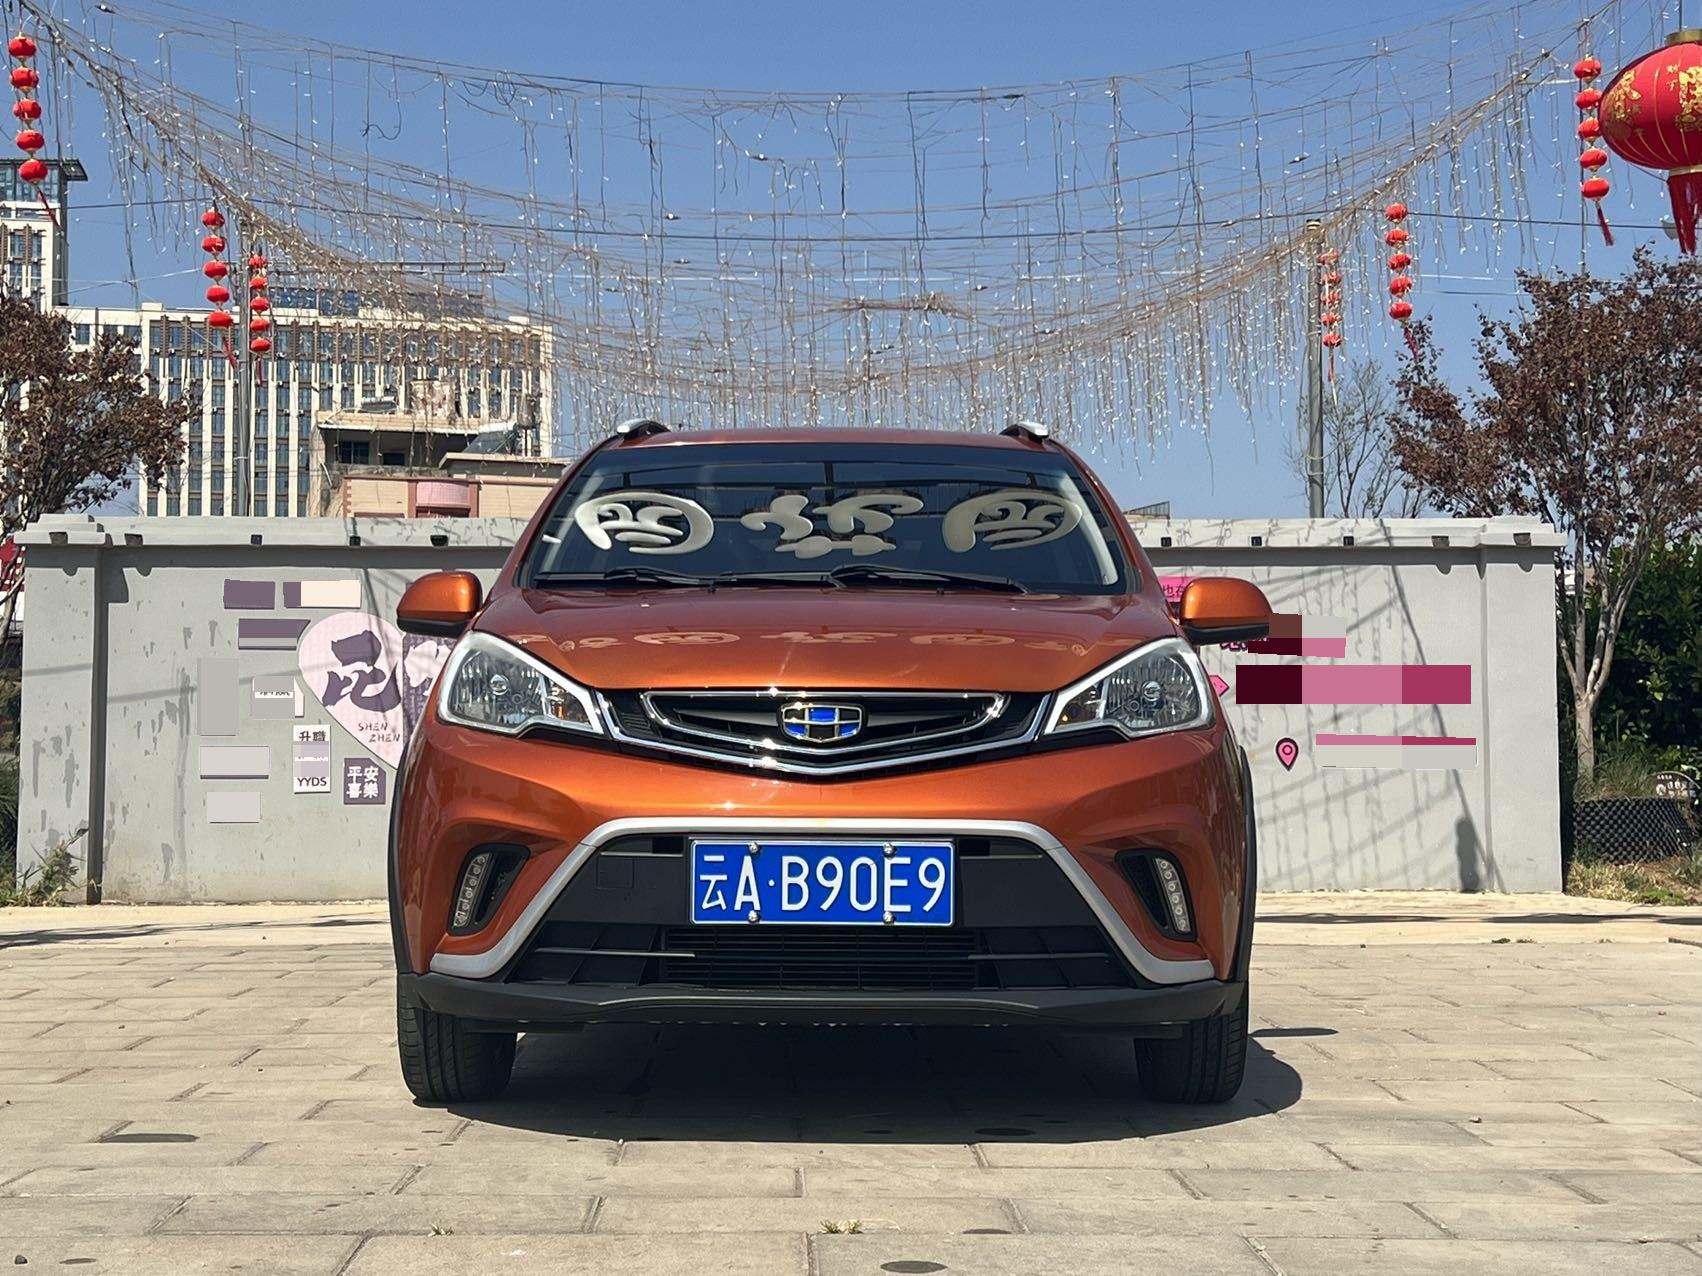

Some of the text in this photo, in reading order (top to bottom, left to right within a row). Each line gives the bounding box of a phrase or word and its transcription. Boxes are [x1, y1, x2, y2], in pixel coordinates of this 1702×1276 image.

[358, 722, 388, 732] SHEN
[369, 733, 401, 743] ZHEN
[297, 776, 327, 787] YYDS
